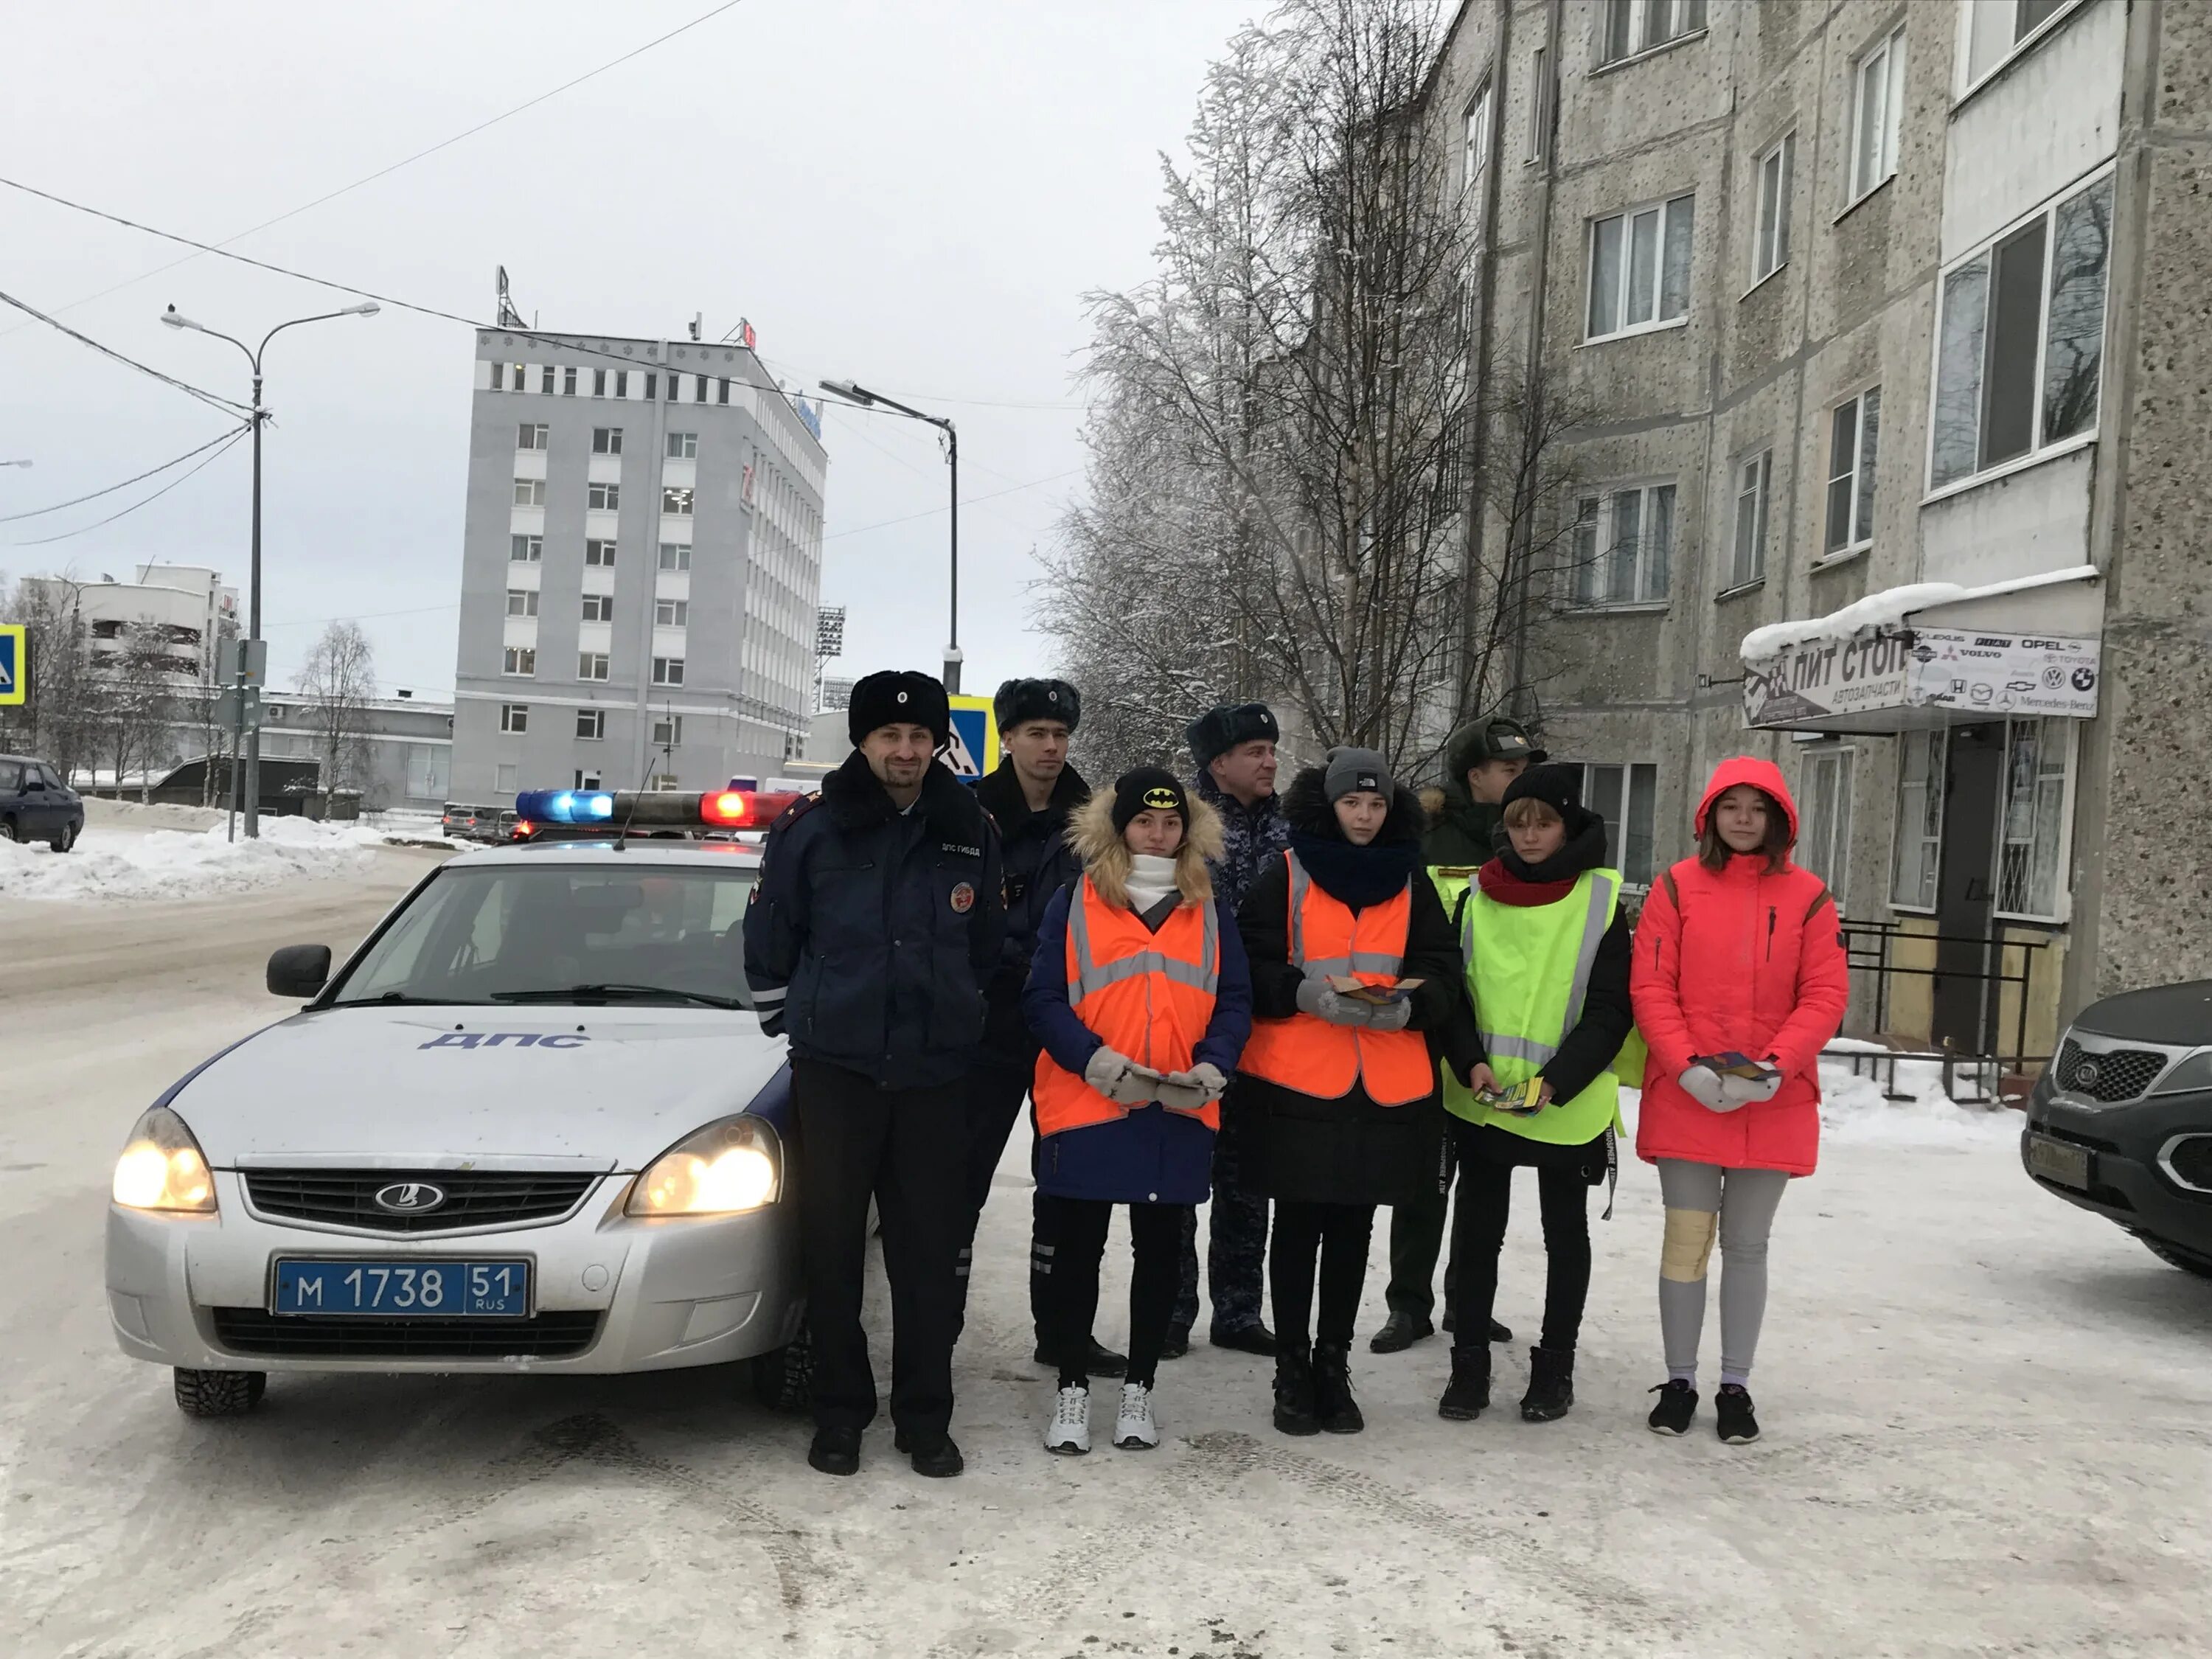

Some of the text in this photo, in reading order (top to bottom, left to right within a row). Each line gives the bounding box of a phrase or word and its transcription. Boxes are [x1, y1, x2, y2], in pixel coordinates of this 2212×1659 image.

[1927, 633, 1965, 642] LEXUS
[1975, 637, 2012, 649] FIAT
[2021, 639, 2066, 651] OPEL
[1959, 649, 2002, 658] VOLVO
[1792, 634, 1906, 691] ПИТ СТОП
[2059, 655, 2096, 665] TOYOTA
[1832, 679, 1902, 705] АВТОЗАПЧАСТИ
[2021, 695, 2095, 712] Mercedes-Benz
[958, 845, 981, 857] ГИБДД
[417, 1033, 591, 1049] ДПС
[344, 1268, 443, 1308] 1738
[472, 1266, 511, 1297] 51
[476, 1298, 505, 1311] RUS
